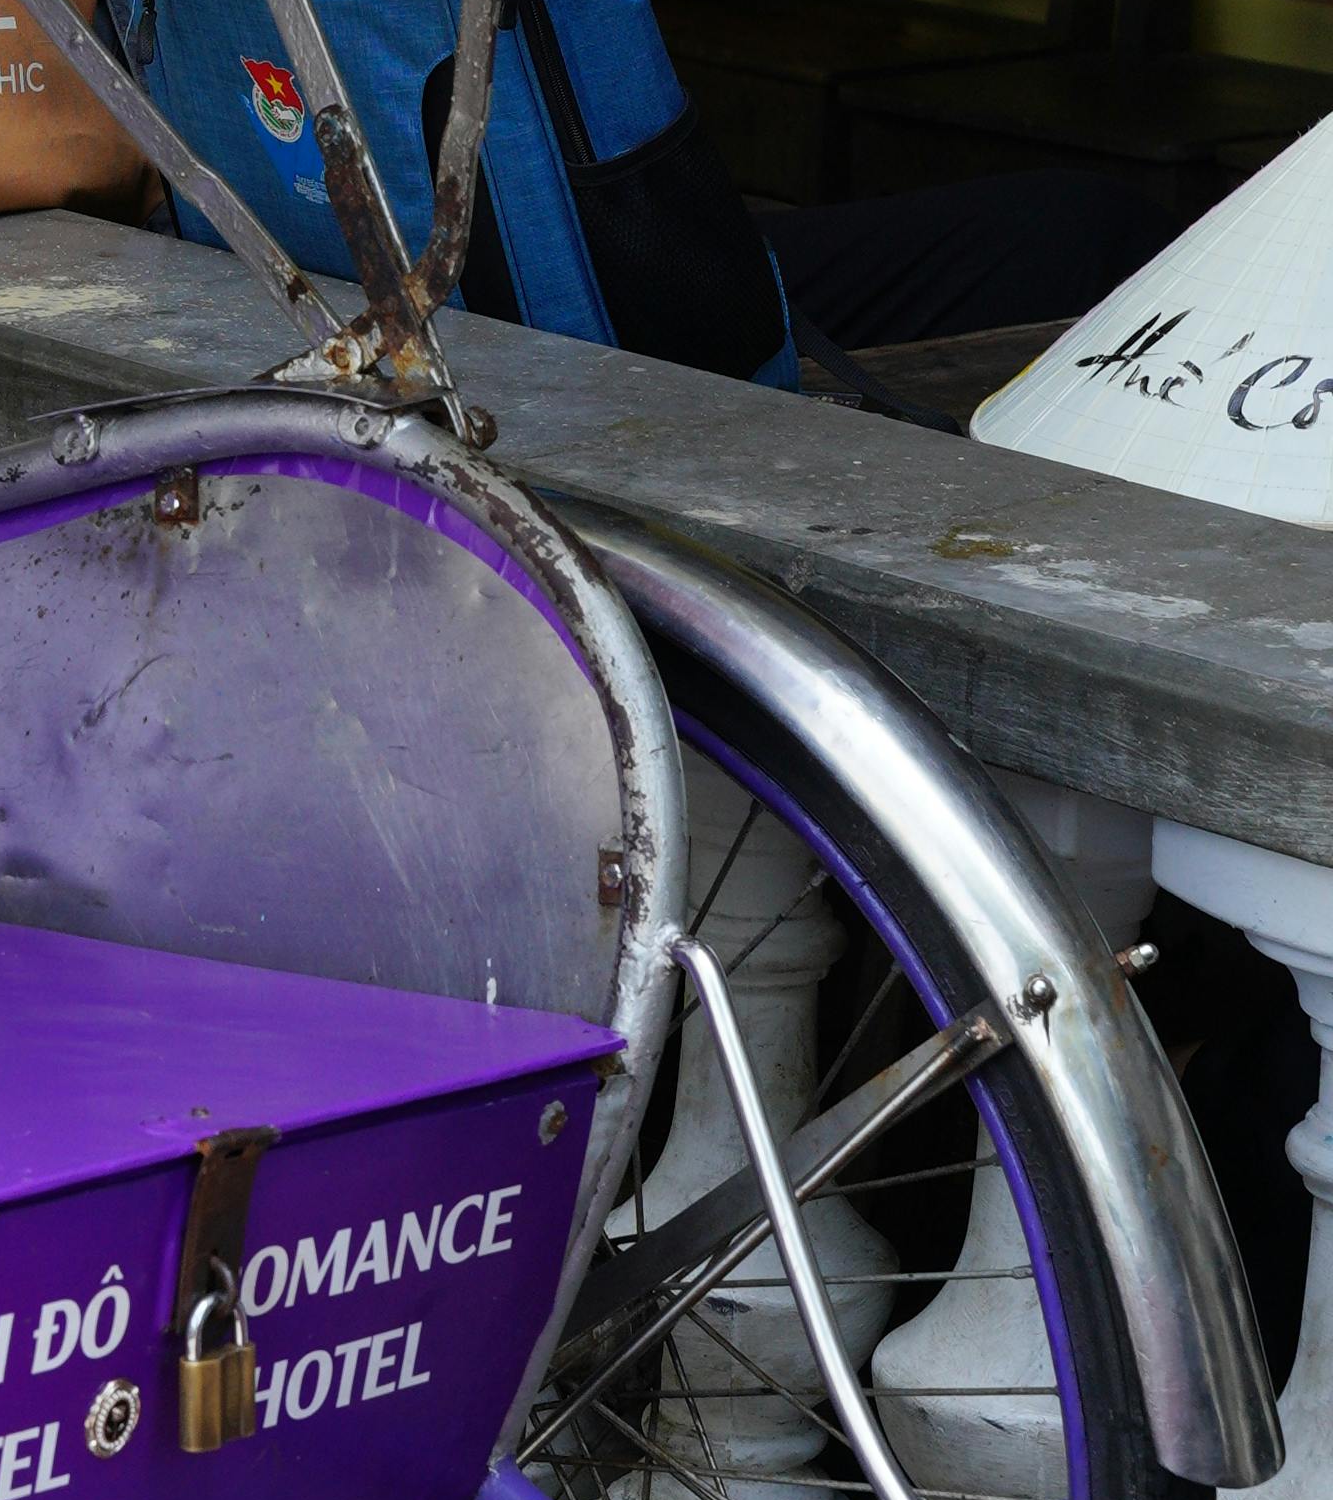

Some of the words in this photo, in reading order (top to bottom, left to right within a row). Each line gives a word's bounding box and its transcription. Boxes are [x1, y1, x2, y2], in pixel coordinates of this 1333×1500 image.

[239, 1184, 522, 1317] OMANCE
[31, 1264, 131, 1375] ĐÔ
[254, 1321, 430, 1429] HOTEL
